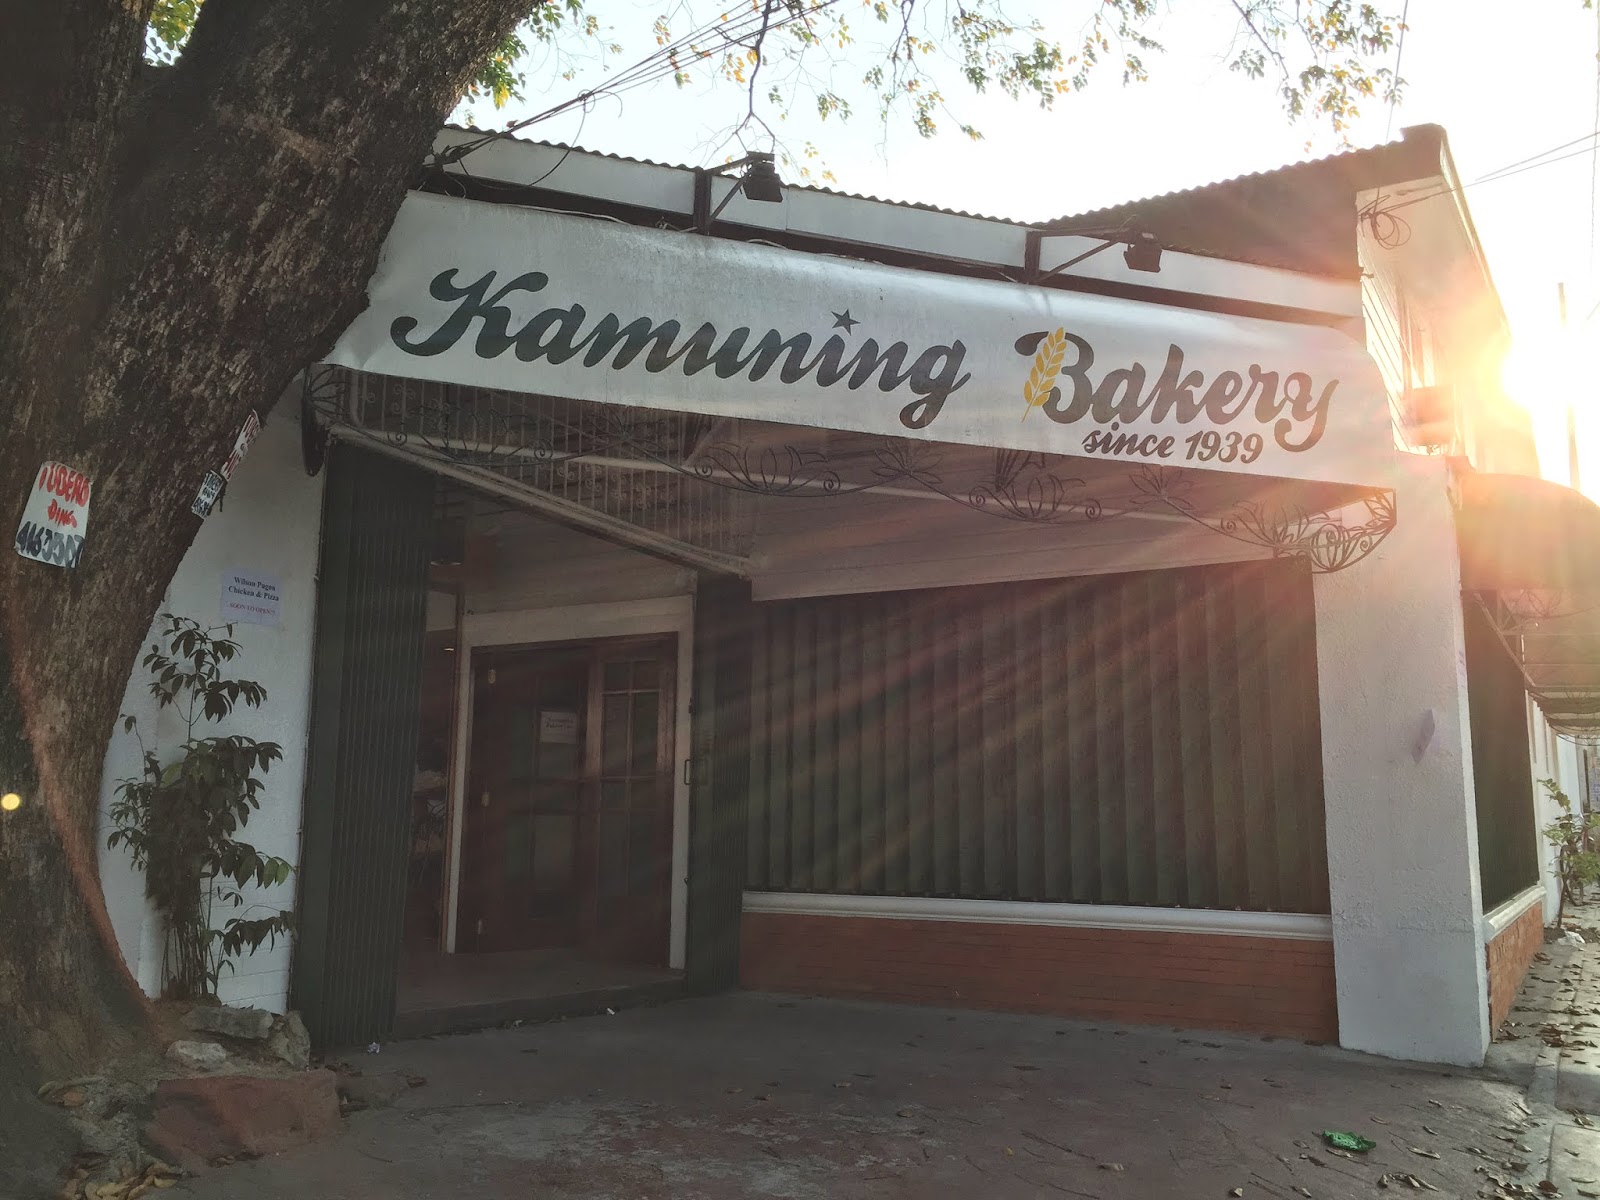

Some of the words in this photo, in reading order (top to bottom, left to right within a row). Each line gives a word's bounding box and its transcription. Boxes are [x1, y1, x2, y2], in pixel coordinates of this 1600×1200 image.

[390, 268, 971, 429] Kamuning
[1014, 328, 1339, 452] Bakery
[1081, 422, 1175, 458] since
[1186, 430, 1263, 464] 1939
[228, 585, 255, 597] Chicken
[264, 593, 279, 601] Pizza
[234, 576, 256, 587] Wilson
